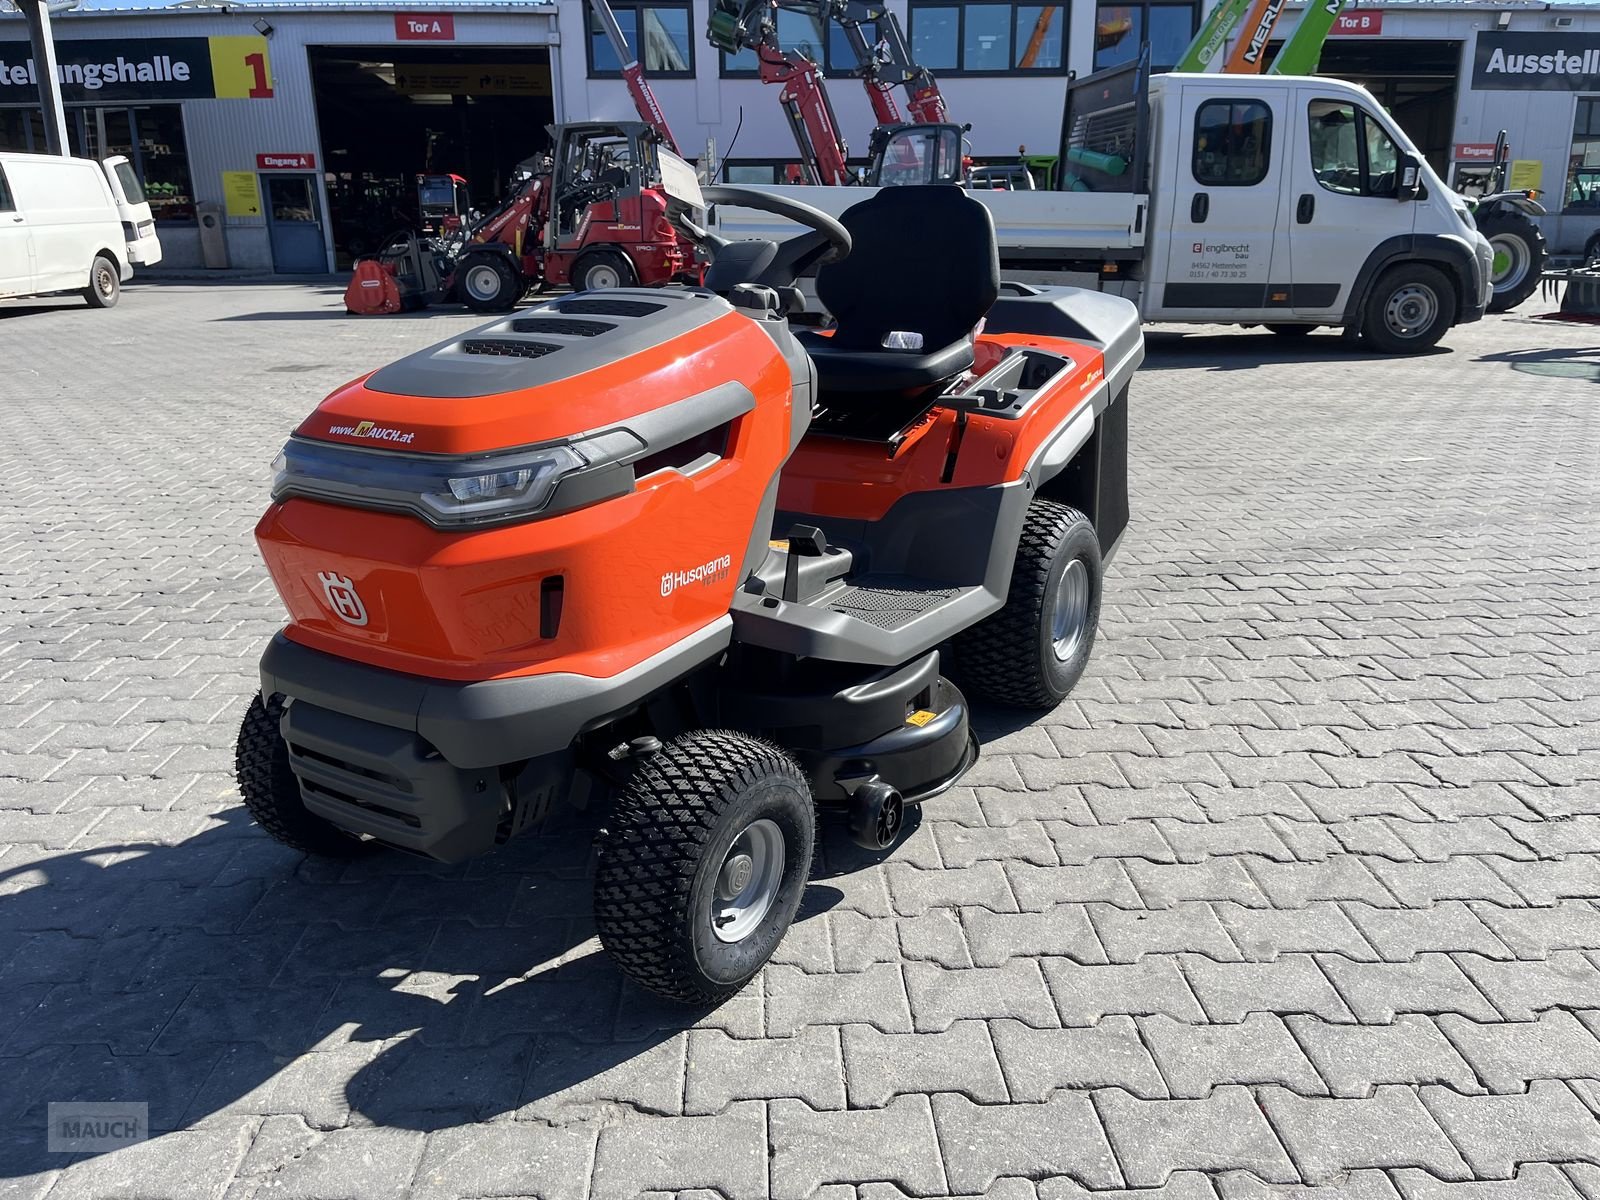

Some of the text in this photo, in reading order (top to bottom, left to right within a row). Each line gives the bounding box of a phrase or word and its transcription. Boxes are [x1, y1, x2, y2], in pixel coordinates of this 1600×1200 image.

[407, 21, 441, 33] Tor A
[1339, 16, 1370, 28] Tor B
[1485, 48, 1600, 74] Ausstell
[0, 53, 274, 98] telngshalle 1
[636, 75, 663, 124] WEIDEMANN
[1463, 147, 1493, 156] Eingang
[264, 157, 307, 166] Eingang A
[1206, 243, 1249, 254] englbrecht
[674, 554, 731, 590] Husqvarna
